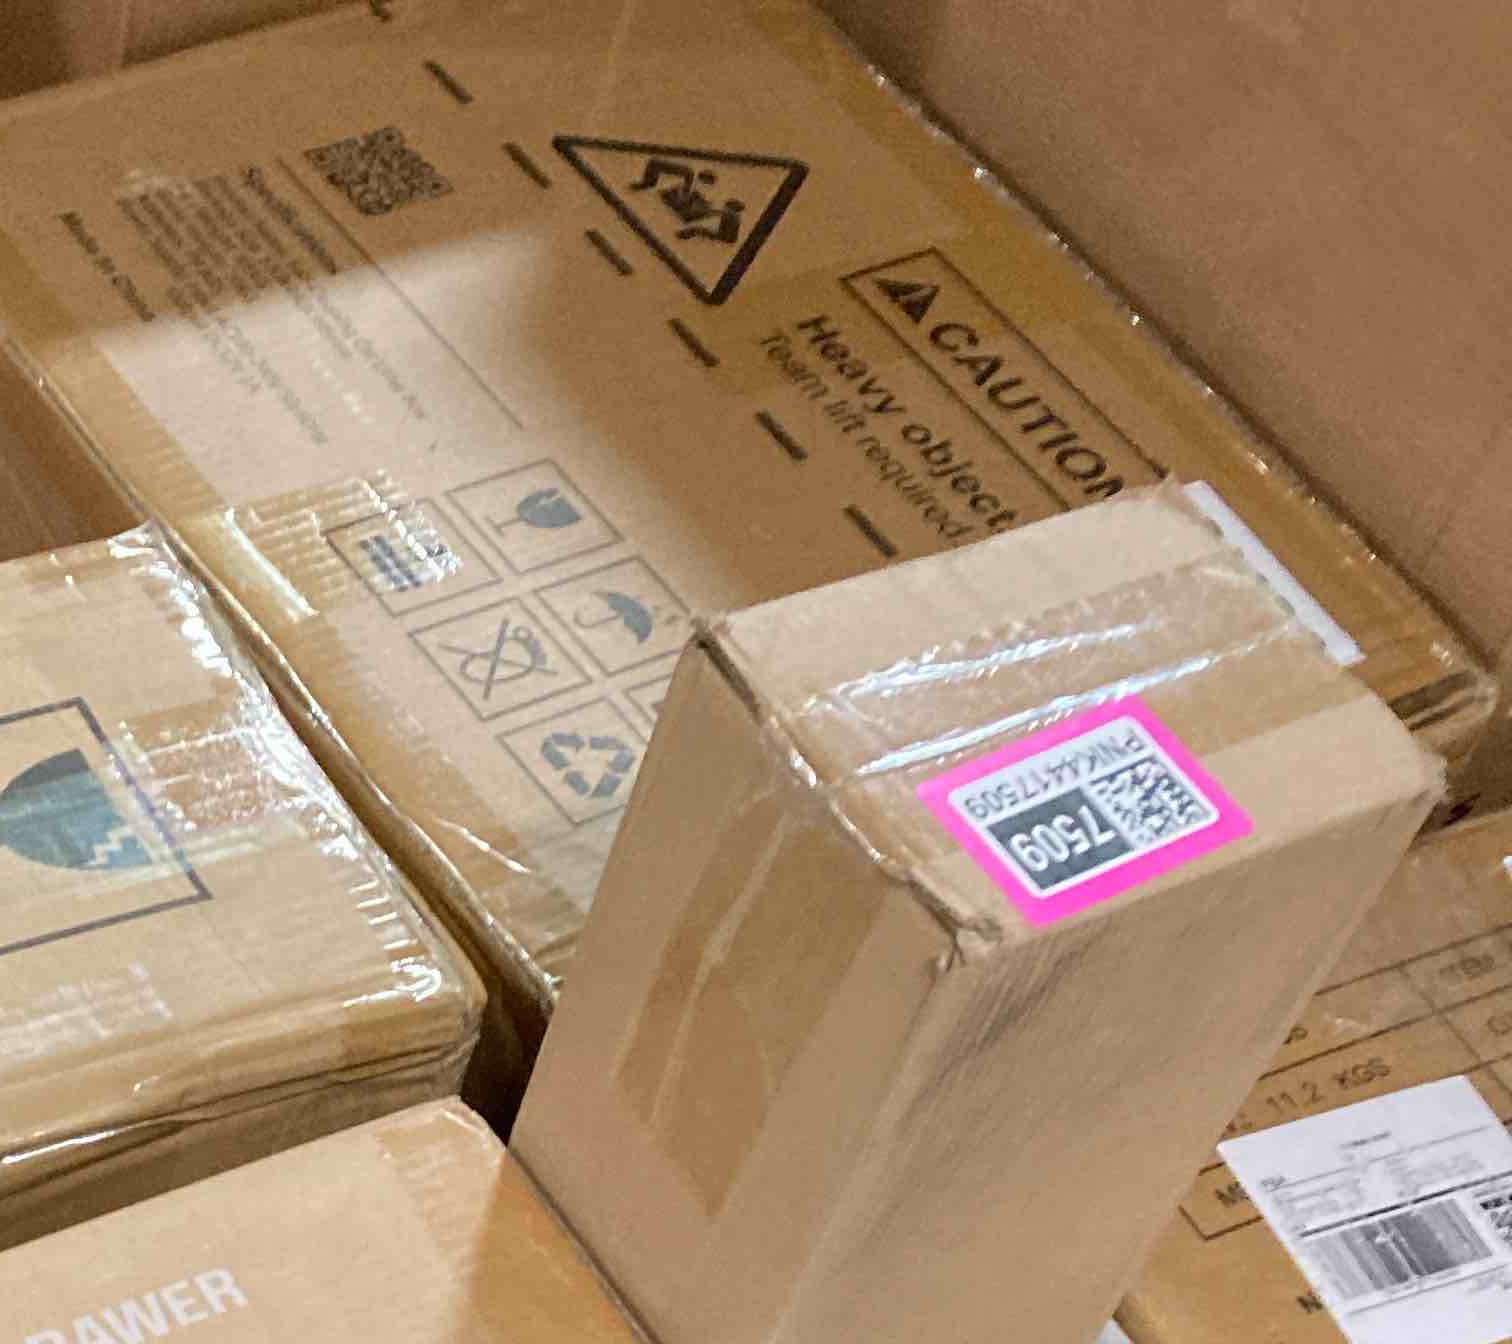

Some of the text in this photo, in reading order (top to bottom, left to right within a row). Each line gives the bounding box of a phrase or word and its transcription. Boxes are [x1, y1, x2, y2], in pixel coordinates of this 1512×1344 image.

[797, 314, 907, 416] Heavy
[963, 728, 1144, 820] PNK4417509
[1006, 808, 1116, 874] 7509
